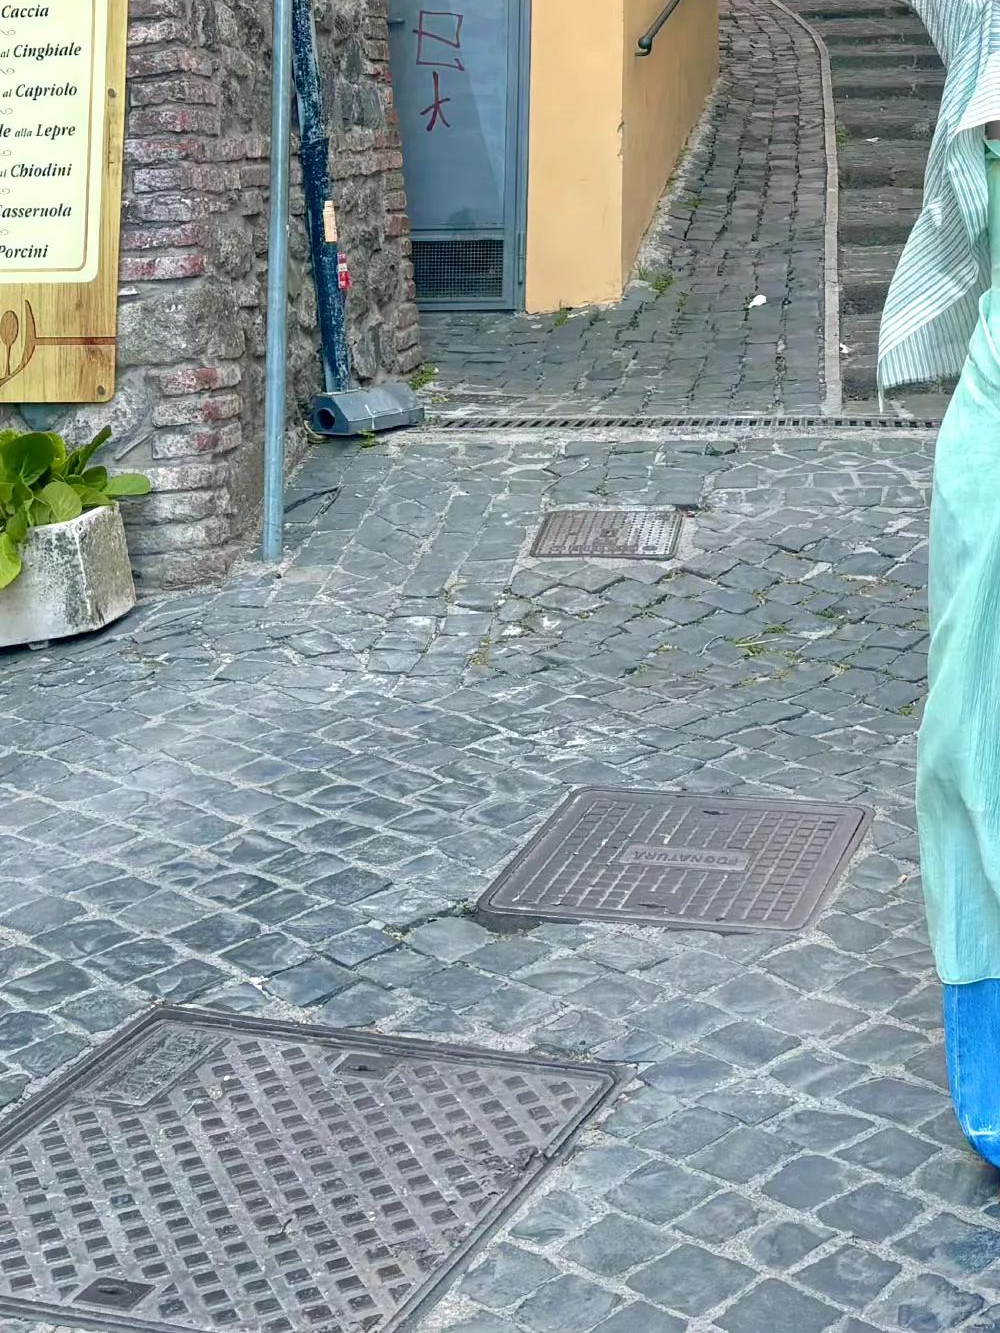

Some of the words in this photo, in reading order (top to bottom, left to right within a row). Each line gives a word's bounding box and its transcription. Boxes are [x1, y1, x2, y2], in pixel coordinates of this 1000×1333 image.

[1, 4, 49, 18] Caccia
[0, 48, 10, 58] al
[13, 42, 82, 61] Cinghiale
[2, 88, 12, 97] al
[15, 82, 78, 100] Capriolo
[14, 127, 32, 138] alla
[35, 123, 76, 140] Lepre
[10, 163, 72, 178] Chiodini
[0, 203, 72, 218] asseruola
[0, 244, 49, 259] Porcini
